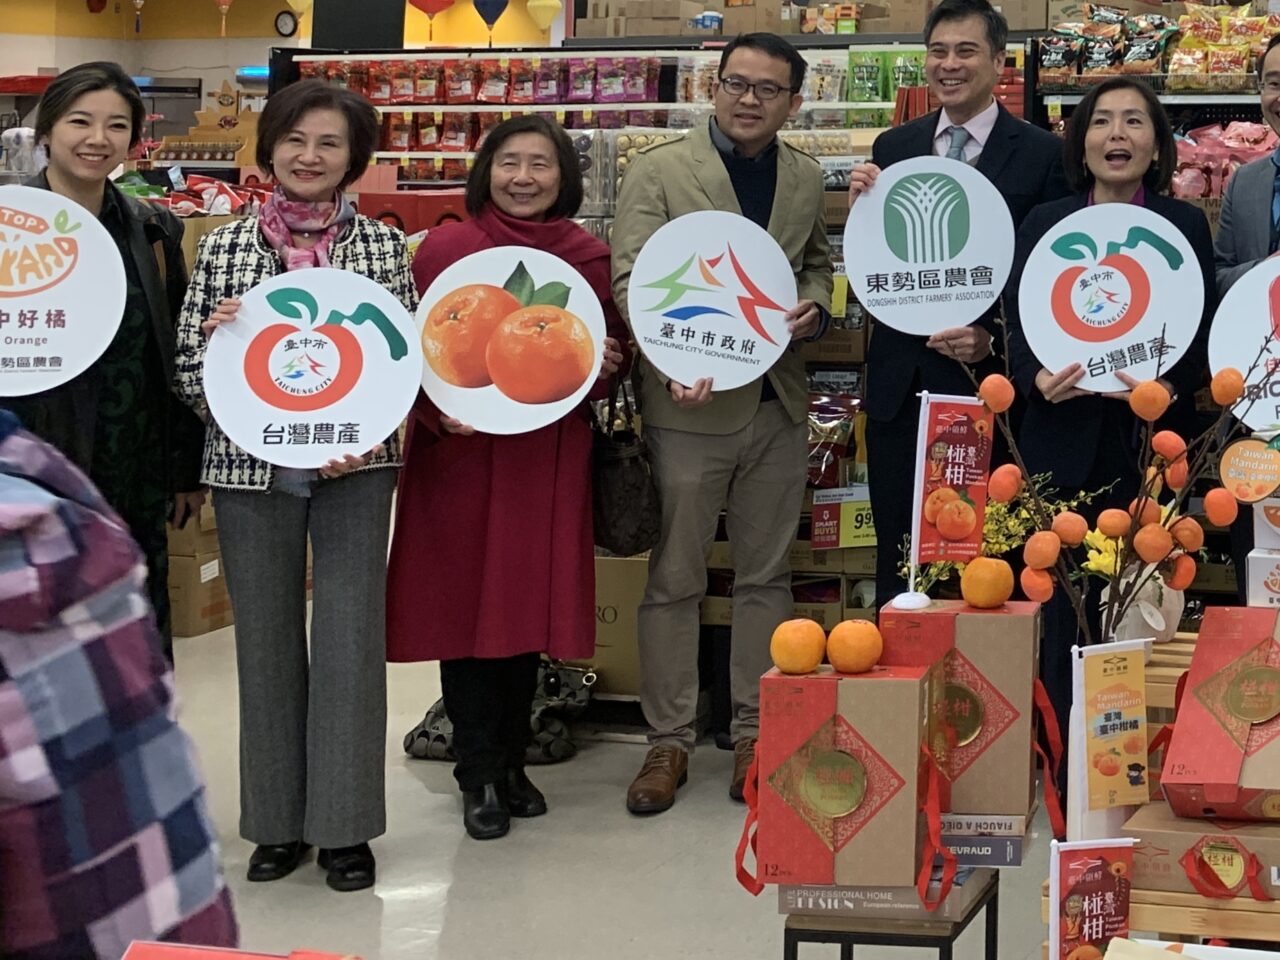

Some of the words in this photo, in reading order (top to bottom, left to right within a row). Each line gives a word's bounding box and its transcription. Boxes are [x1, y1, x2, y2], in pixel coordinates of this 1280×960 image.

[1, 209, 38, 228] TOP
[866, 265, 994, 294] 東勢區農會
[1079, 270, 1114, 292] 臺中市
[867, 297, 897, 308] DONGSHIH
[898, 296, 924, 306] DISTRICT
[955, 290, 995, 301] ASSOCIATION
[1081, 313, 1118, 328] TAICHUNG
[4, 336, 48, 346] Orange
[284, 338, 328, 351] 臺中市
[659, 322, 757, 356] 臺中市政府
[643, 336, 683, 351] TAICHUNG
[684, 344, 703, 355] CITY
[704, 348, 761, 366] GOVERNMENT
[1087, 336, 1171, 378] 台灣農產
[274, 376, 314, 395] TAICHUNG
[314, 376, 333, 394] CITY
[262, 422, 361, 445] 台灣農產
[1239, 447, 1274, 459] Taiwan
[945, 444, 966, 486] 椪柑
[1230, 457, 1278, 471] Mandarin
[1097, 690, 1130, 702] Taiwan
[1097, 698, 1141, 710] Mandarin
[1099, 720, 1139, 735] 臺中柑橘
[1169, 763, 1185, 776] 12
[763, 863, 779, 876] 12
[797, 890, 865, 900] PROFESSIONAL
[867, 892, 893, 901] HOME
[797, 898, 854, 910] DESIGN
[1082, 891, 1104, 942] 椪柑
